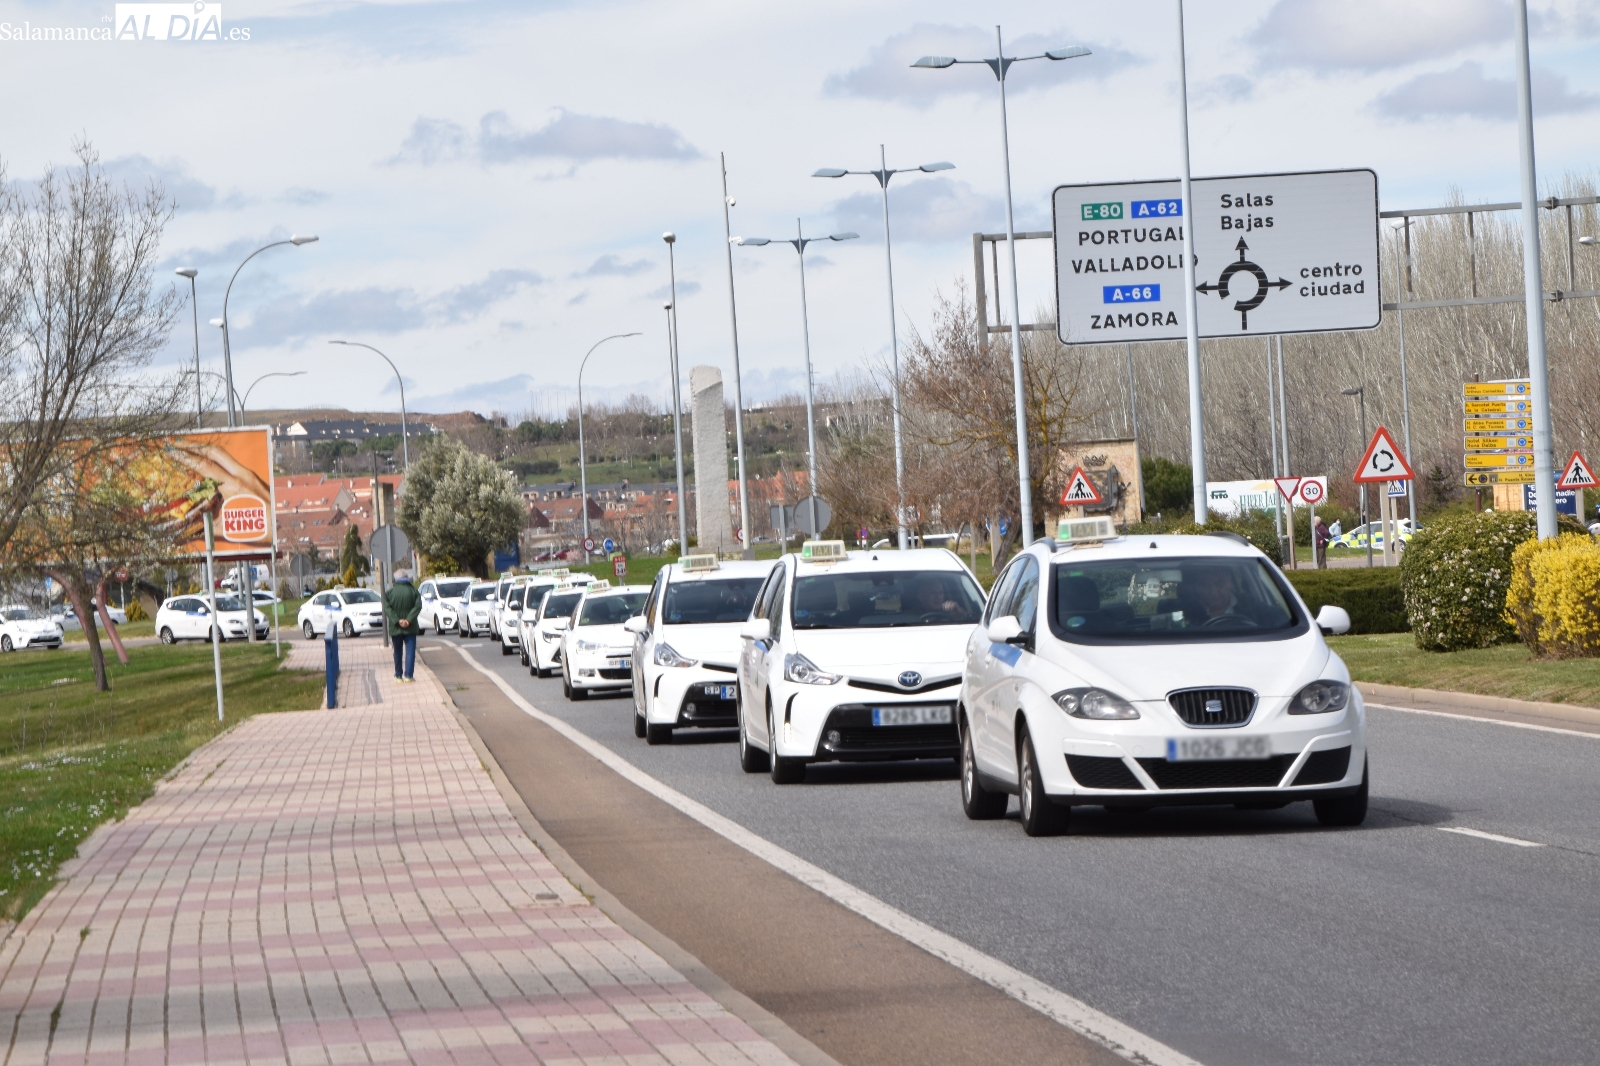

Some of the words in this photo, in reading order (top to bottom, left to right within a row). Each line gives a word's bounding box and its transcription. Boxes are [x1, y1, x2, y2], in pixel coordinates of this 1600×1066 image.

[1220, 193, 1274, 209] Salas
[1083, 206, 1121, 218] E-80
[1138, 201, 1178, 216] A-62
[1220, 213, 1274, 232] Bajas
[1300, 263, 1363, 279] centro
[1112, 287, 1153, 302] A-66
[1299, 280, 1365, 297] ciudad
[1090, 311, 1179, 330] ZAMORA
[1305, 487, 1319, 496] 30
[224, 510, 264, 519] BURGER
[225, 519, 265, 532] KING
[812, 545, 832, 556] TAXI
